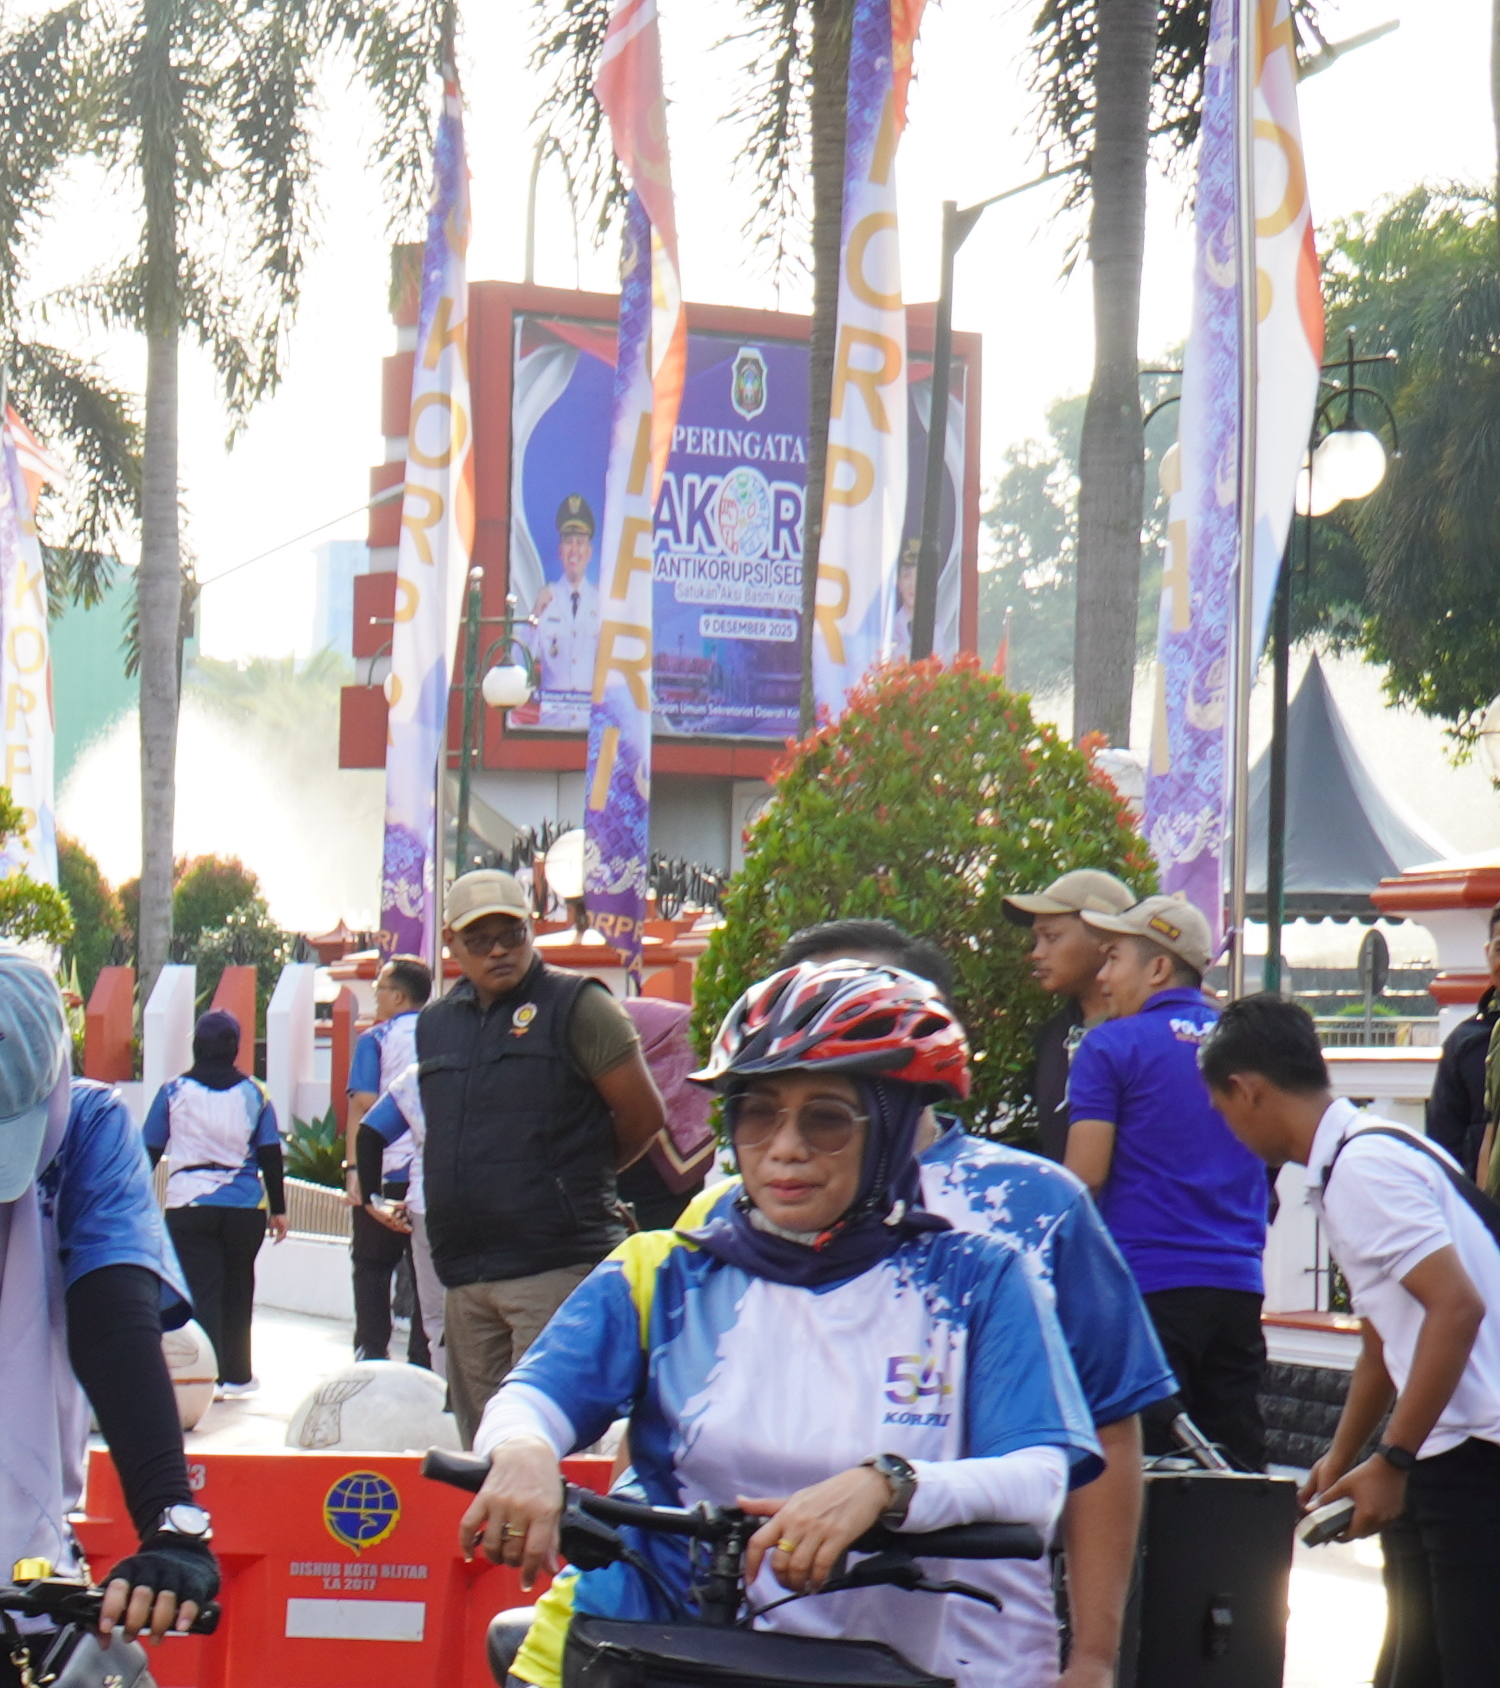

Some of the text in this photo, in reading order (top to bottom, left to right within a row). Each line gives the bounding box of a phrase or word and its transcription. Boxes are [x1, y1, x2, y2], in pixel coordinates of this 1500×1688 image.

[670, 424, 808, 464] PERINGATA
[657, 556, 803, 587] ANTIKORUPSI SED
[712, 620, 766, 636] DESEMBER
[768, 622, 794, 638] 2025
[885, 1354, 953, 1406] 54
[187, 1464, 207, 1491] 3
[289, 1561, 428, 1579] DISHUB KOTA BLITAR
[343, 1578, 377, 1591] 2017
